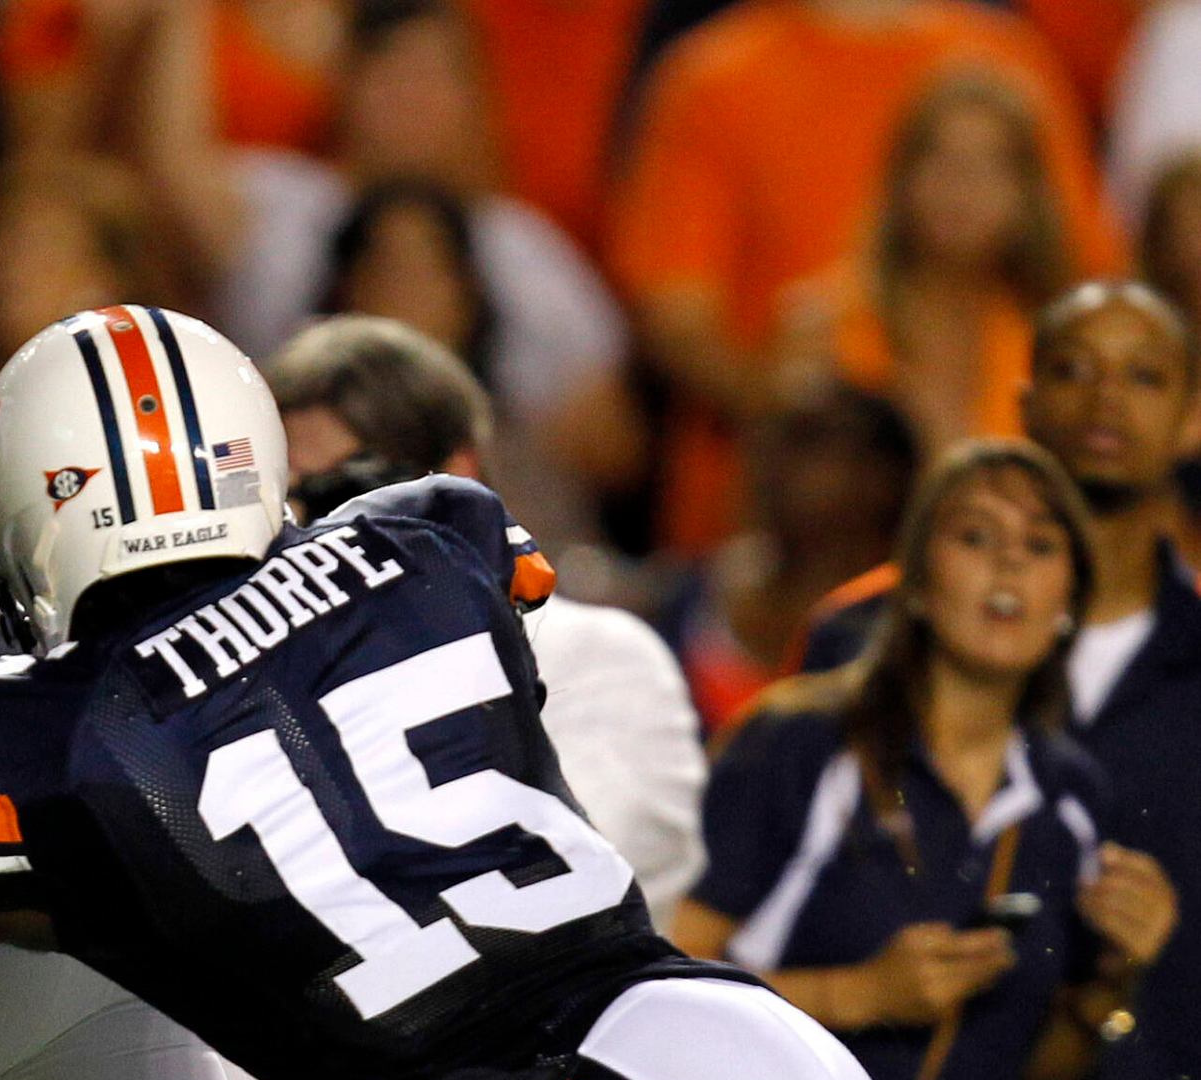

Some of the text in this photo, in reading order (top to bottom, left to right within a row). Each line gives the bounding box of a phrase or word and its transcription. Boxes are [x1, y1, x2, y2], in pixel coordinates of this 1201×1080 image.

[91, 507, 115, 529] 15
[123, 523, 229, 553] WAR EAGLE
[134, 525, 405, 699] THORPE
[198, 631, 635, 1021] 15
